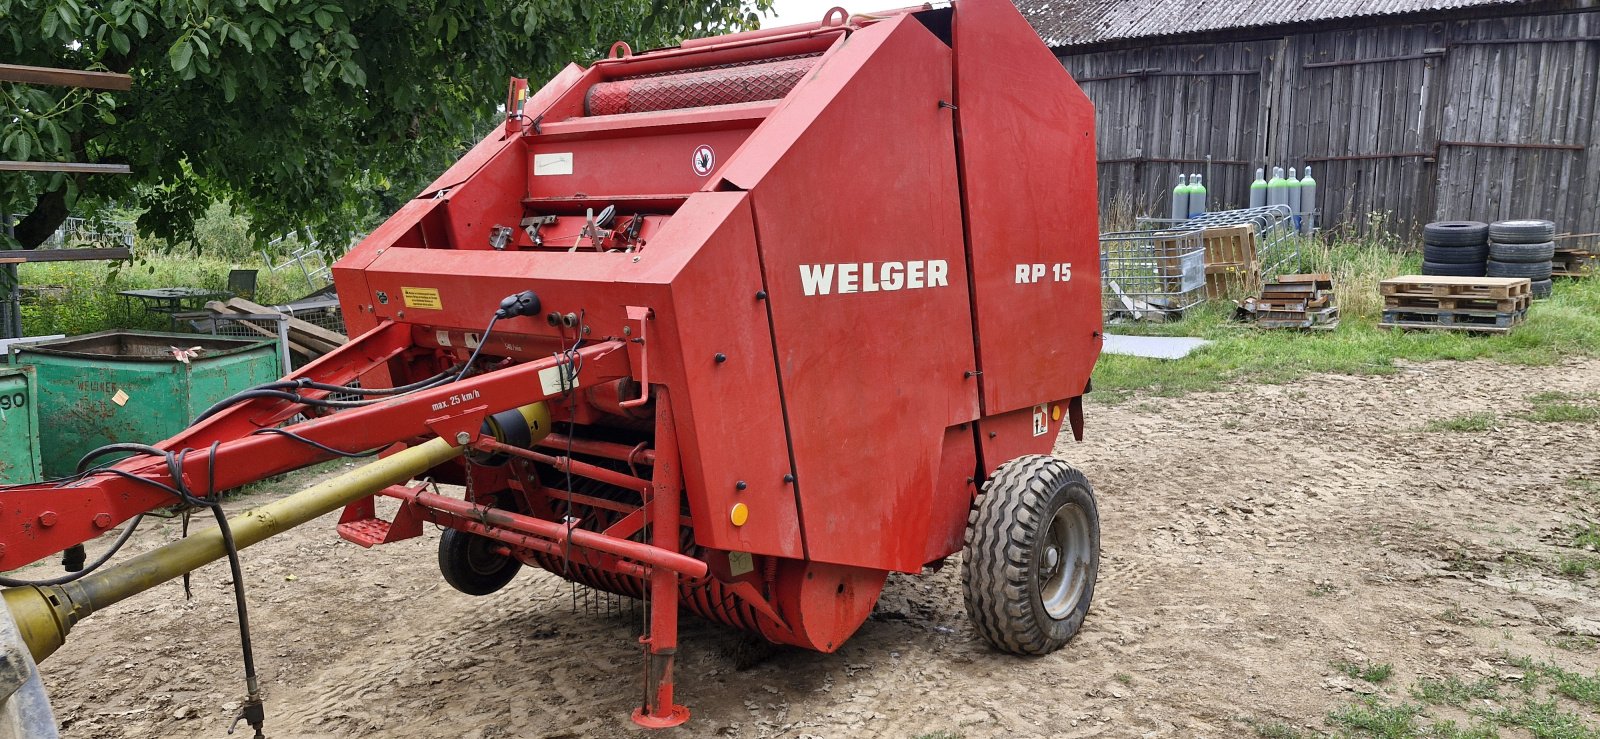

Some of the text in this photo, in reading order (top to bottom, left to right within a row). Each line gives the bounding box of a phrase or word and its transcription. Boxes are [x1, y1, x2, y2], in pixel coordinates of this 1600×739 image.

[799, 259, 949, 296] WELGER
[1015, 262, 1072, 284] RP 15
[0, 392, 25, 410] 90
[431, 389, 480, 411] max. 25 km/h
